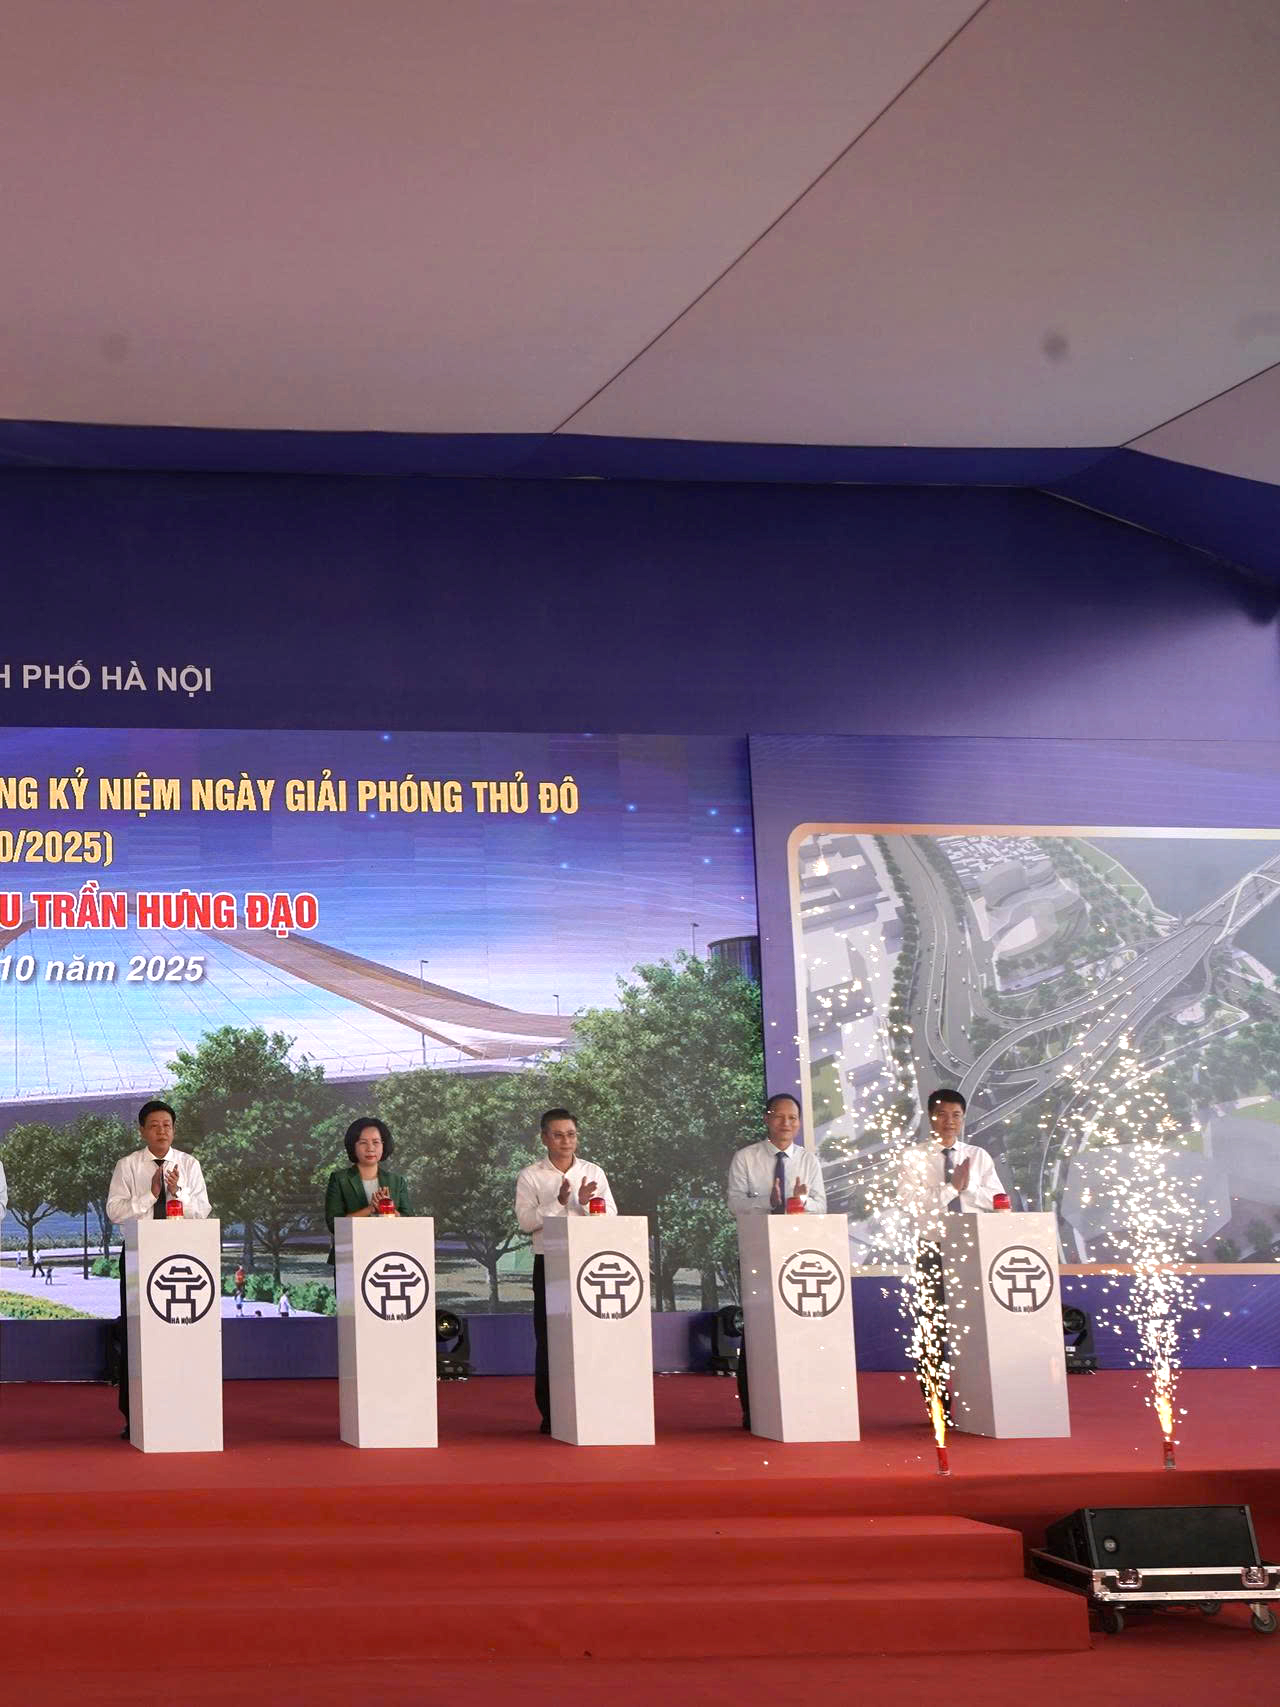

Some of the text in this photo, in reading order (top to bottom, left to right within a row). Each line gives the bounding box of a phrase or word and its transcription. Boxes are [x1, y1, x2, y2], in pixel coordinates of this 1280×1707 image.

[22, 659, 91, 690] PHỐ
[101, 660, 147, 691] HÀ
[157, 664, 212, 698] NỘI
[49, 767, 89, 811] KỶ
[99, 771, 181, 818] NIỆM
[191, 772, 276, 813] NGÀY
[285, 768, 347, 813] GIẢI
[358, 773, 463, 814] PHÓNG
[471, 770, 529, 814] THỦ
[538, 775, 580, 815] ĐÔ
[32, 881, 127, 930] TRẦN
[137, 890, 236, 931] HƯNG
[245, 894, 319, 938] ĐẠO
[0, 955, 35, 982] 10
[44, 954, 116, 982] năm
[125, 955, 206, 983] 2025
